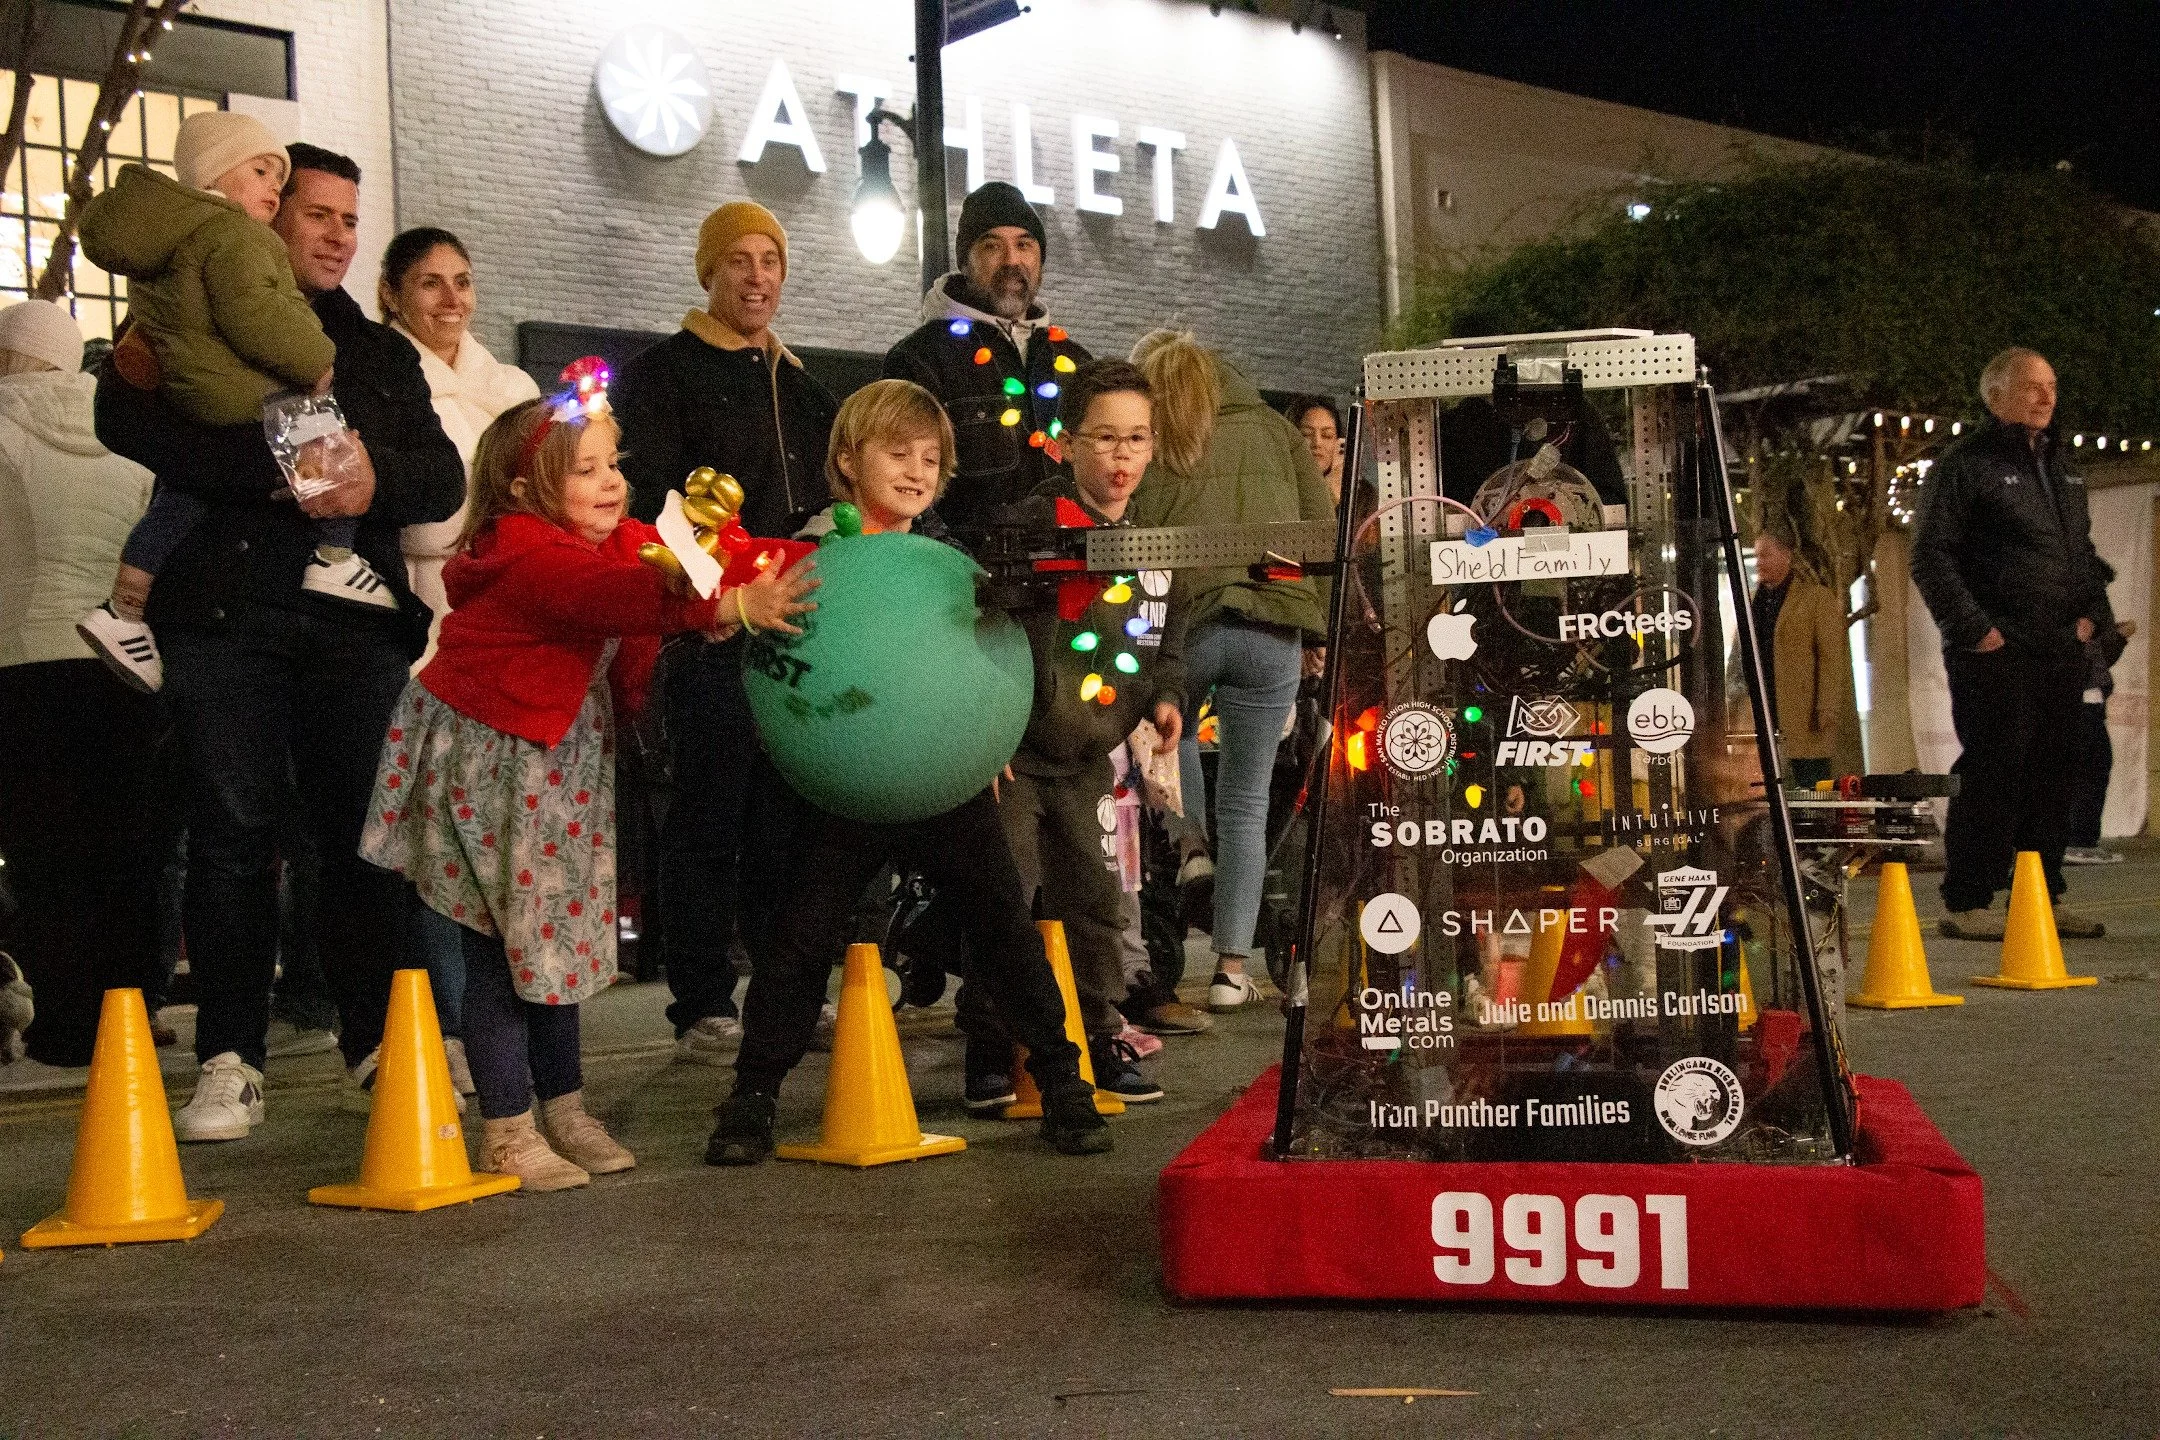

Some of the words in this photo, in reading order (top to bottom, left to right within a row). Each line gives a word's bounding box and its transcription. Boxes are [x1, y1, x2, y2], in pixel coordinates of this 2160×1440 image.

[738, 57, 1266, 237] ATHLETA
[1438, 548, 1507, 580] Shield
[1517, 543, 1611, 575] Family
[1559, 610, 1693, 641] FRCtees
[1386, 703, 1409, 719] UNION
[1411, 701, 1431, 709] HIGH
[1635, 705, 1686, 730] ebb
[1431, 705, 1454, 732] SCHOOL
[1376, 719, 1388, 746] MATEO
[1377, 748, 1388, 763] SAN
[1496, 741, 1593, 767] FIRST
[1388, 766, 1427, 781] ESTABLIHED
[1368, 802, 1400, 818] The
[1612, 803, 1720, 831] INTUITIVE
[1371, 817, 1547, 847] SOBRATO
[1636, 835, 1701, 847] SURGICAL
[1442, 846, 1547, 866] Organization
[1663, 875, 1686, 883] GENE
[1688, 874, 1711, 882] HAAS
[1667, 939, 1714, 947] FOUNDATION
[1360, 985, 1452, 1010] Online
[1479, 998, 1531, 1026] Julie
[1537, 996, 1577, 1023] and
[1583, 992, 1658, 1021] Dennis
[1664, 989, 1748, 1018] Carlson
[1360, 1010, 1453, 1034] Metals
[1370, 1100, 1417, 1128] Iron
[1425, 1097, 1519, 1128] Panther
[1526, 1095, 1631, 1127] Families
[1431, 1191, 1690, 1290] 9991
